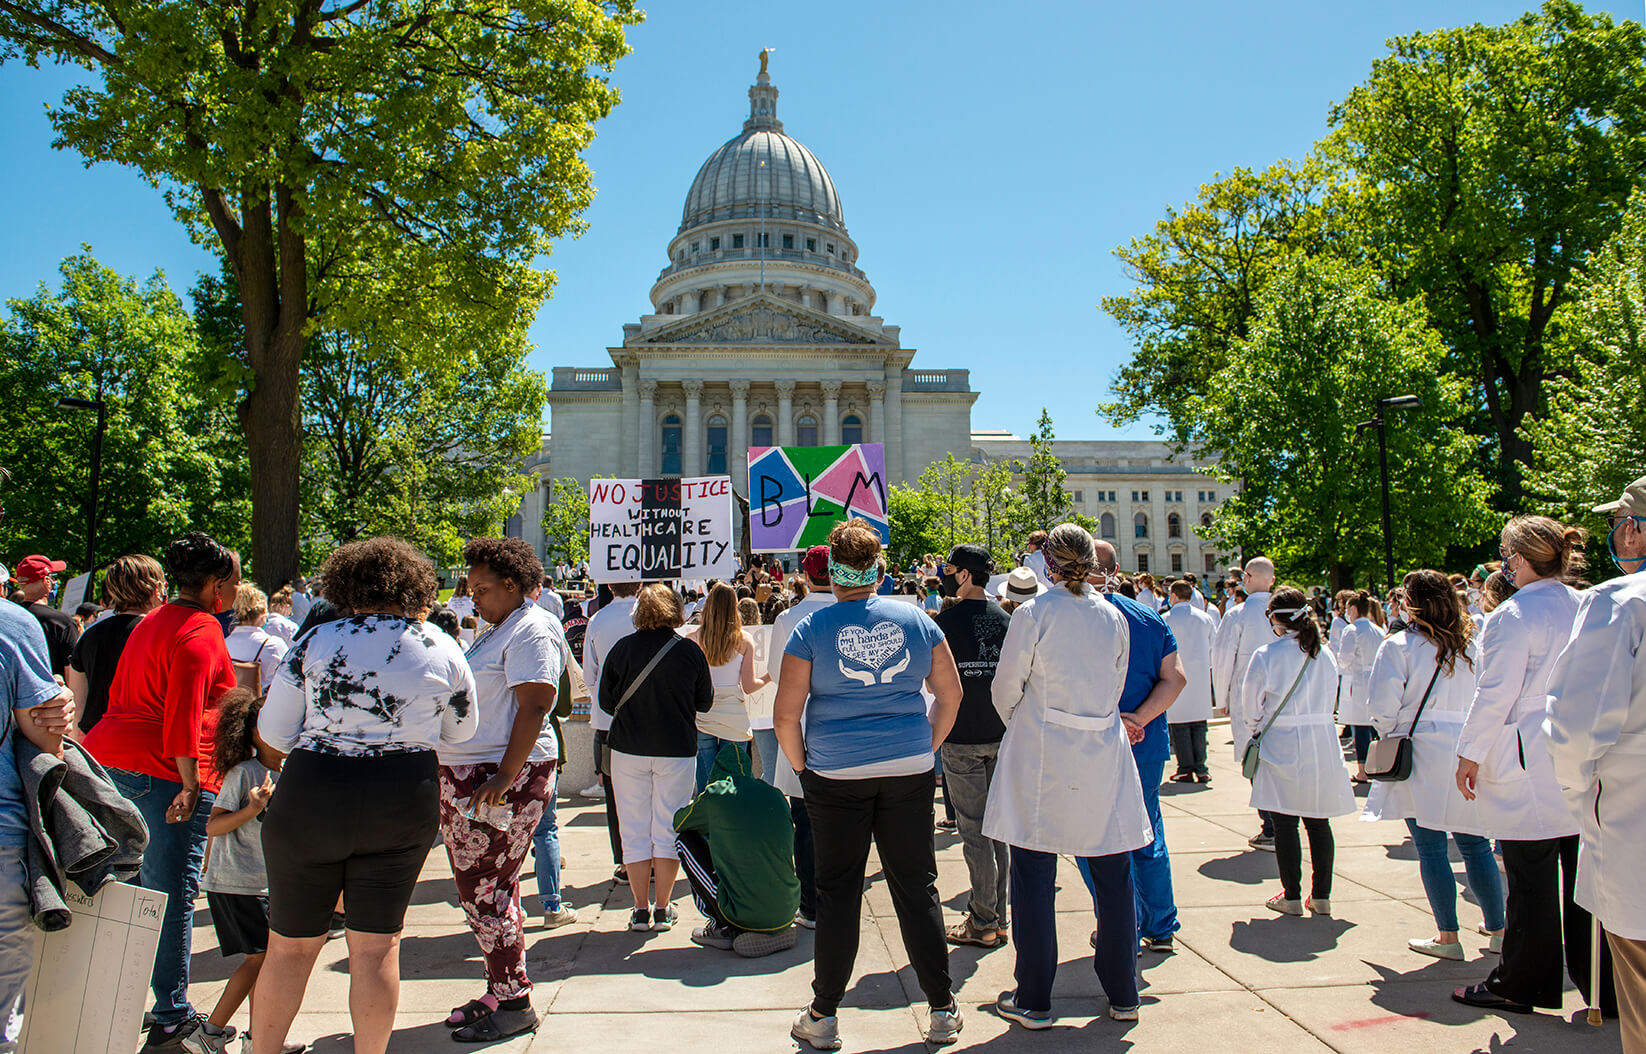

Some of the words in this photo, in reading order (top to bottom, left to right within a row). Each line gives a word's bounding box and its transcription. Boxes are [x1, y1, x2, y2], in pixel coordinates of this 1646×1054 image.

[591, 482, 625, 505] NO
[631, 479, 730, 503] JUSTICE
[760, 471, 888, 527] BLM
[628, 507, 691, 521] WITHOUT
[590, 519, 712, 538] HEALTHCARE
[606, 539, 729, 572] EQUALITY
[840, 637, 854, 646] my
[857, 632, 888, 644] hands
[889, 627, 902, 637] ARE
[874, 623, 894, 633] THINK
[842, 645, 856, 653] FULL
[878, 638, 903, 647] SHOULD
[853, 651, 866, 659] SEE
[138, 896, 162, 920] Total
